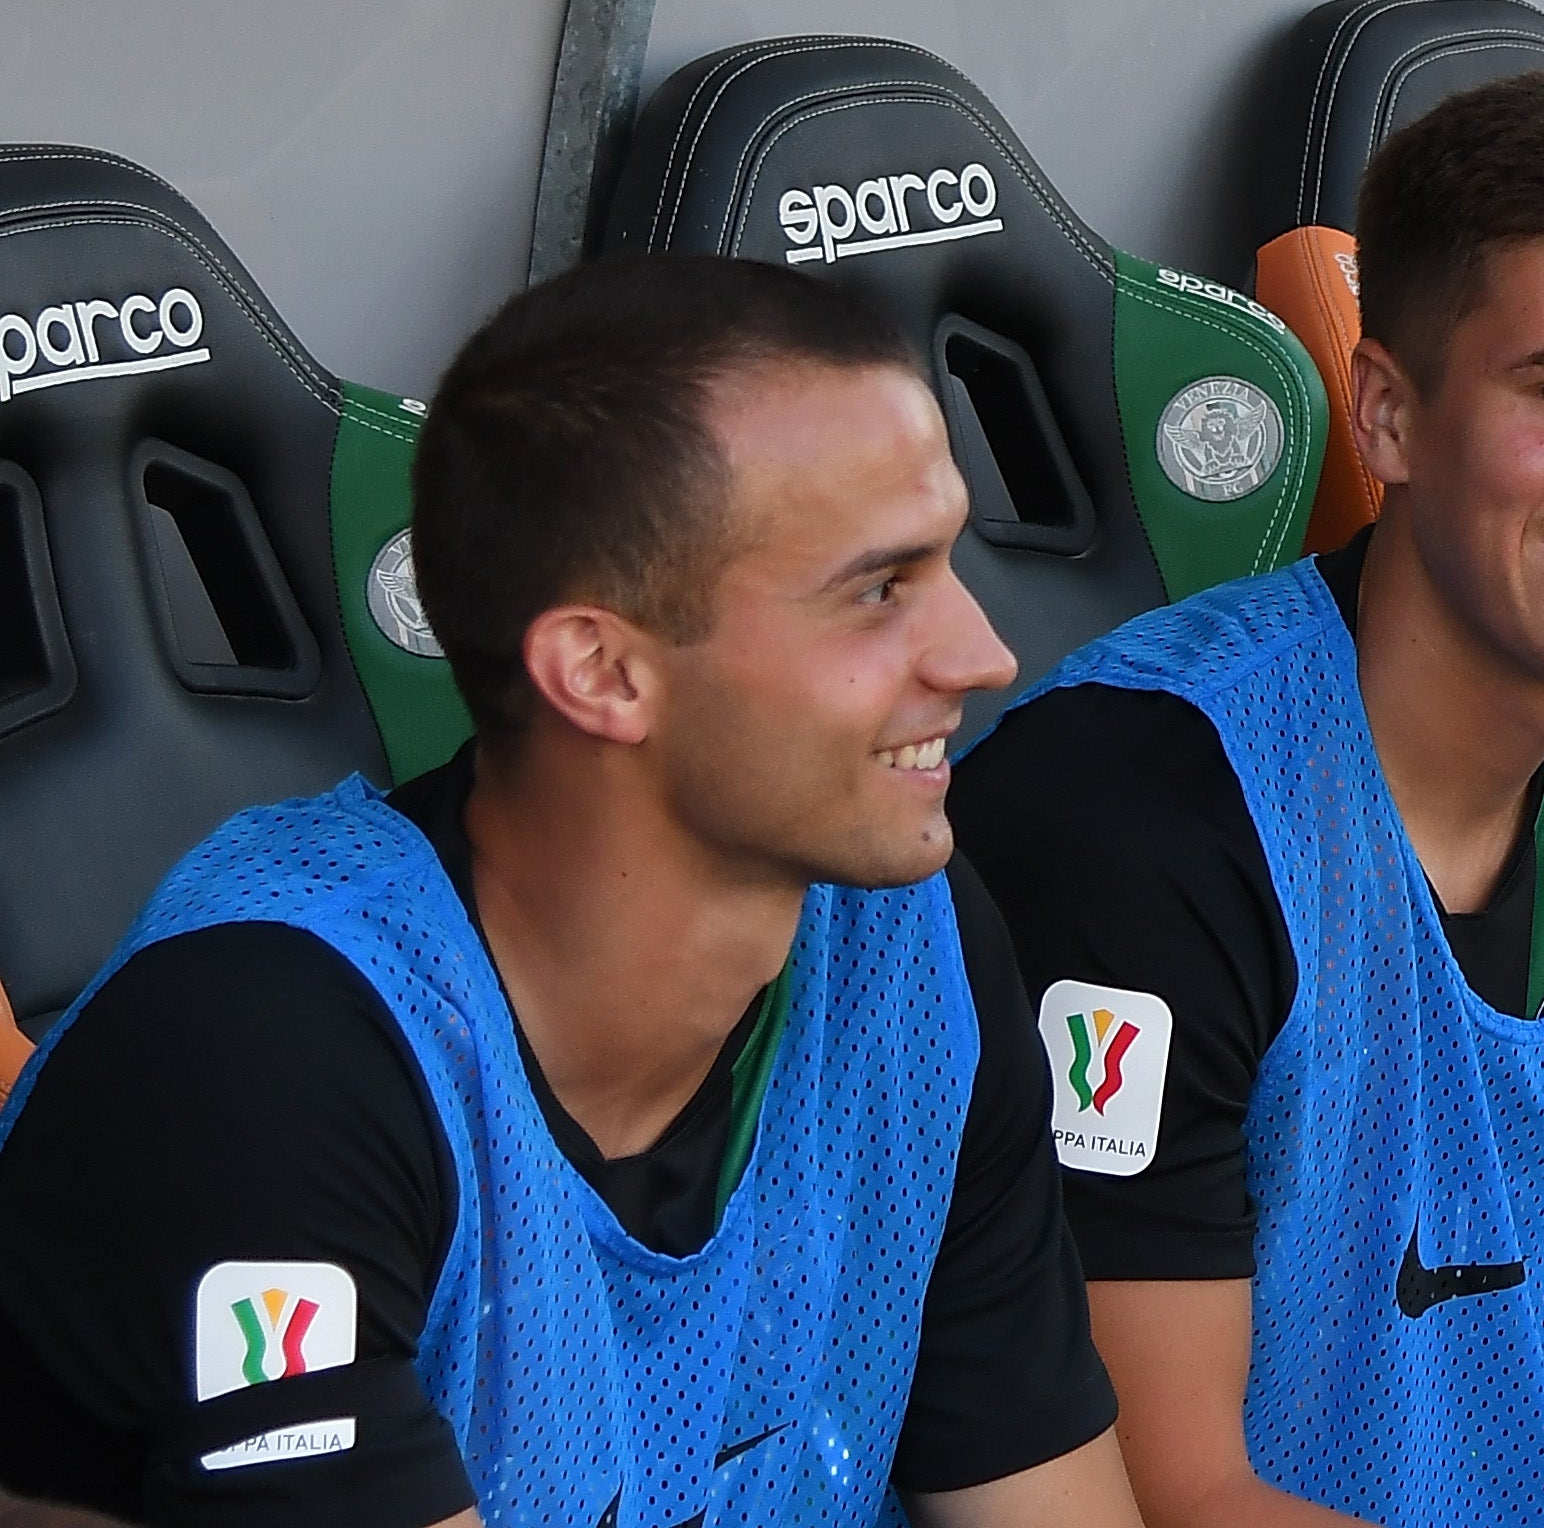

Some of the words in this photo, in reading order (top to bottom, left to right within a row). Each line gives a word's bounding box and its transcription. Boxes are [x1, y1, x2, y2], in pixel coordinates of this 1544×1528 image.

[779, 162, 1004, 264] sparco
[1156, 268, 1287, 336] sparco
[1172, 381, 1251, 412] VENEZIA
[1091, 1135, 1146, 1158] ITALIA
[277, 1434, 344, 1451] ITALIA
